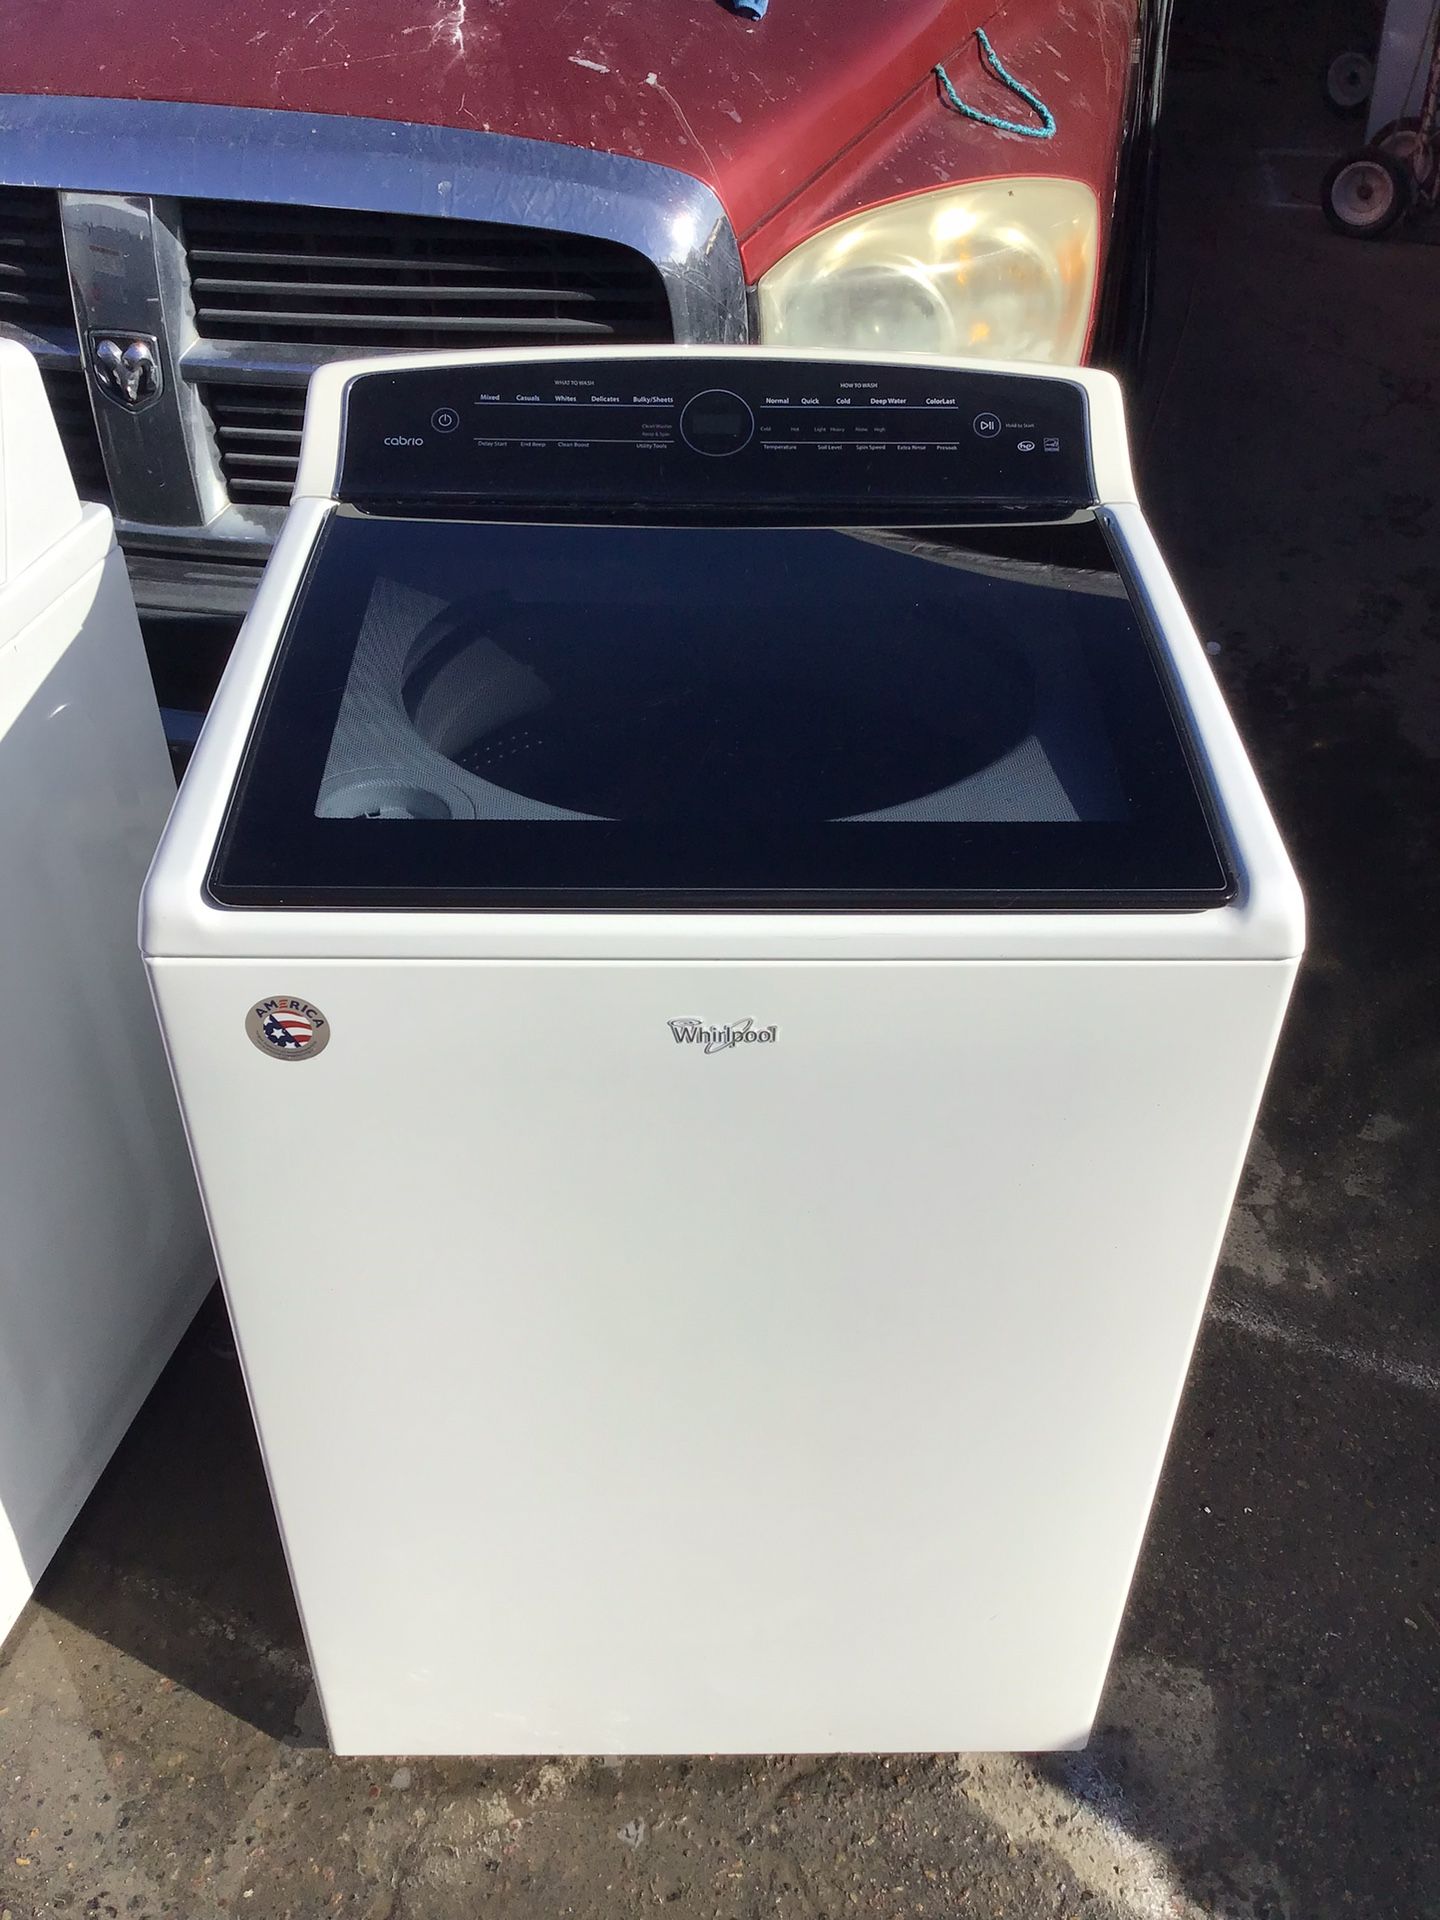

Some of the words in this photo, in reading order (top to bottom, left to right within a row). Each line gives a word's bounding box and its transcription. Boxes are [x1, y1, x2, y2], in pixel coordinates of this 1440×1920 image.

[591, 395, 620, 403] Delicates
[633, 396, 674, 404] Bulky/Sheets
[384, 436, 424, 446] cabrio
[256, 999, 325, 1028] AMERICA
[668, 1018, 777, 1054] Whirlpool
